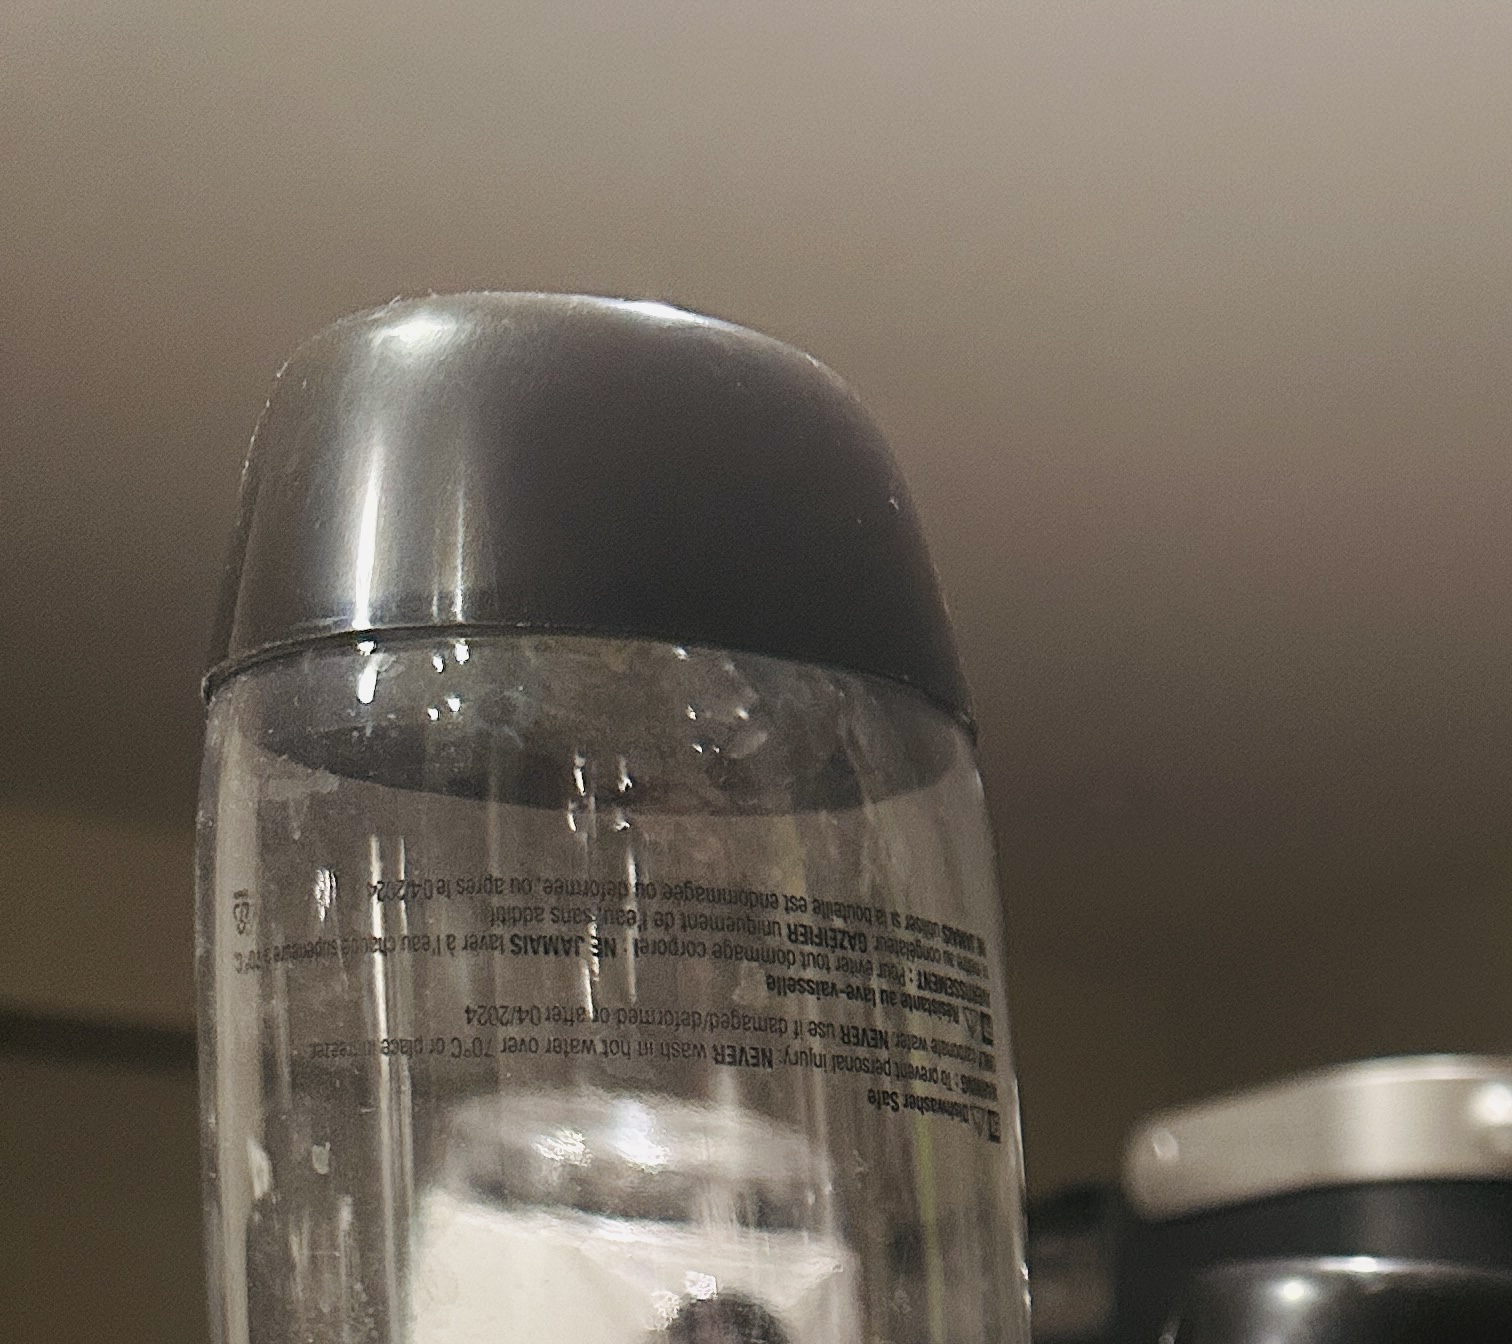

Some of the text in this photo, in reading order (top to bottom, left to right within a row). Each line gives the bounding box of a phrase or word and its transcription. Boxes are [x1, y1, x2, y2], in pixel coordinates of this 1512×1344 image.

[436, 880, 452, 899] le
[456, 876, 503, 900] après
[510, 879, 532, 895] ou
[634, 882, 657, 901] ou
[662, 881, 779, 912] endommagée
[549, 906, 591, 924] sans
[782, 894, 807, 915] est
[812, 898, 873, 926] bouteille
[654, 911, 675, 930] de
[680, 913, 782, 939] uniquement
[876, 909, 888, 929] la
[890, 911, 901, 930] si
[400, 934, 441, 956] l'eau
[445, 934, 457, 957] à
[462, 934, 504, 956] laver
[510, 933, 585, 956] JAMAIS
[589, 935, 617, 960] NE
[633, 936, 707, 958] corporel
[786, 923, 868, 955] GAZÉIFIER
[711, 939, 796, 969] dommage
[799, 951, 831, 975] tout
[876, 963, 906, 987] Pour
[765, 973, 876, 1008] lave-vaisselle
[879, 989, 898, 1007] au
[464, 1005, 542, 1026] 04/2024
[544, 1006, 586, 1025] after
[792, 1019, 803, 1040] if
[808, 1020, 835, 1038] use
[839, 1025, 889, 1050] NEVER
[381, 1034, 423, 1057] place
[430, 1037, 446, 1054] or
[451, 1036, 494, 1058] 70°C
[499, 1036, 539, 1054] over
[545, 1037, 597, 1056] water
[601, 1039, 631, 1060] hot
[637, 1041, 654, 1058] in
[659, 1041, 707, 1059] wash
[712, 1044, 773, 1070] NEVER
[831, 1054, 892, 1079] personal
[895, 1061, 938, 1085] prevent
[867, 1089, 970, 1124] Dishwasher Safe
